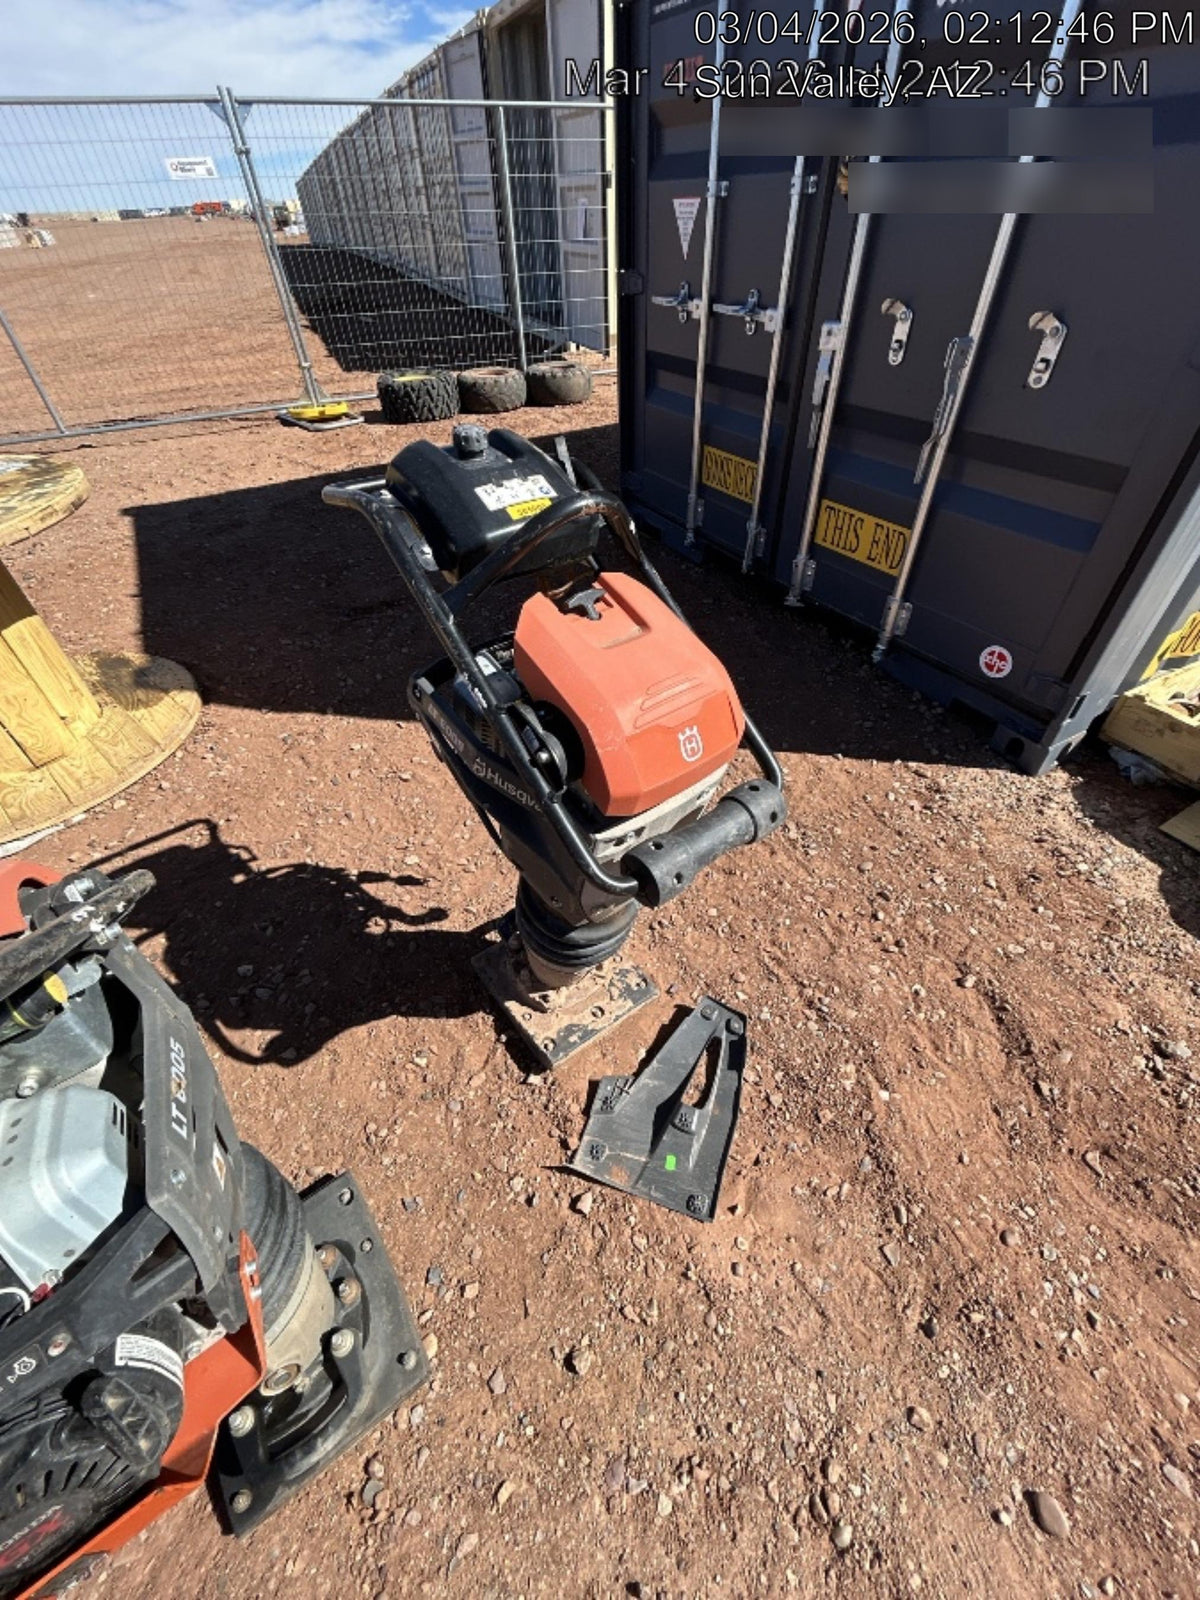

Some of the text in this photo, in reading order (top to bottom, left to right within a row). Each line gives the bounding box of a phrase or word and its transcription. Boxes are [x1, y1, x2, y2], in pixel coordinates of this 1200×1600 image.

[822, 505, 907, 570] THIS END
[170, 1101, 188, 1140] LT
